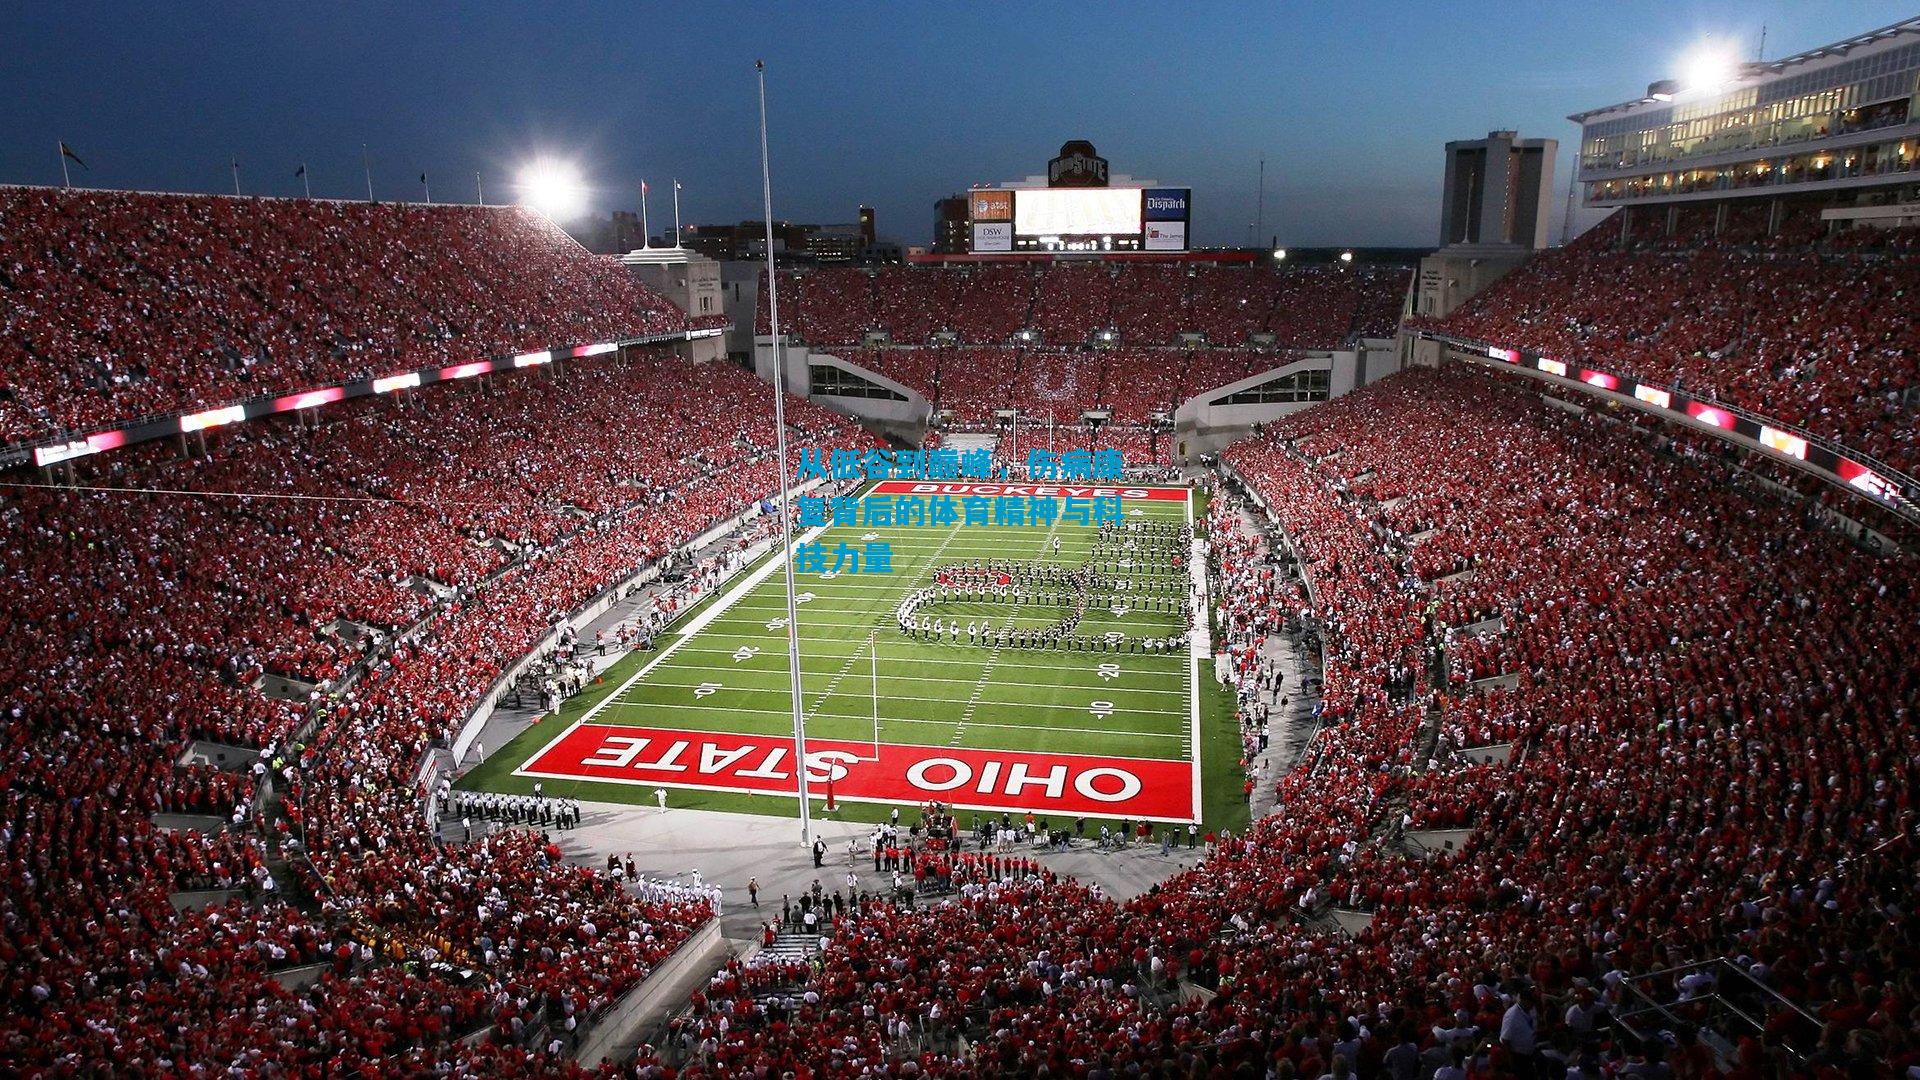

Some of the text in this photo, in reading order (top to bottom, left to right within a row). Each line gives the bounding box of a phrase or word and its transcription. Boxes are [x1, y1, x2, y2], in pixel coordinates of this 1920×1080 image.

[1147, 198, 1185, 211] Dispatch
[983, 228, 1002, 236] DSW
[911, 483, 1150, 498] BUCKEYES
[1097, 664, 1120, 678] 20
[1089, 701, 1114, 715] 10
[582, 735, 1142, 803] OHIO STATE
